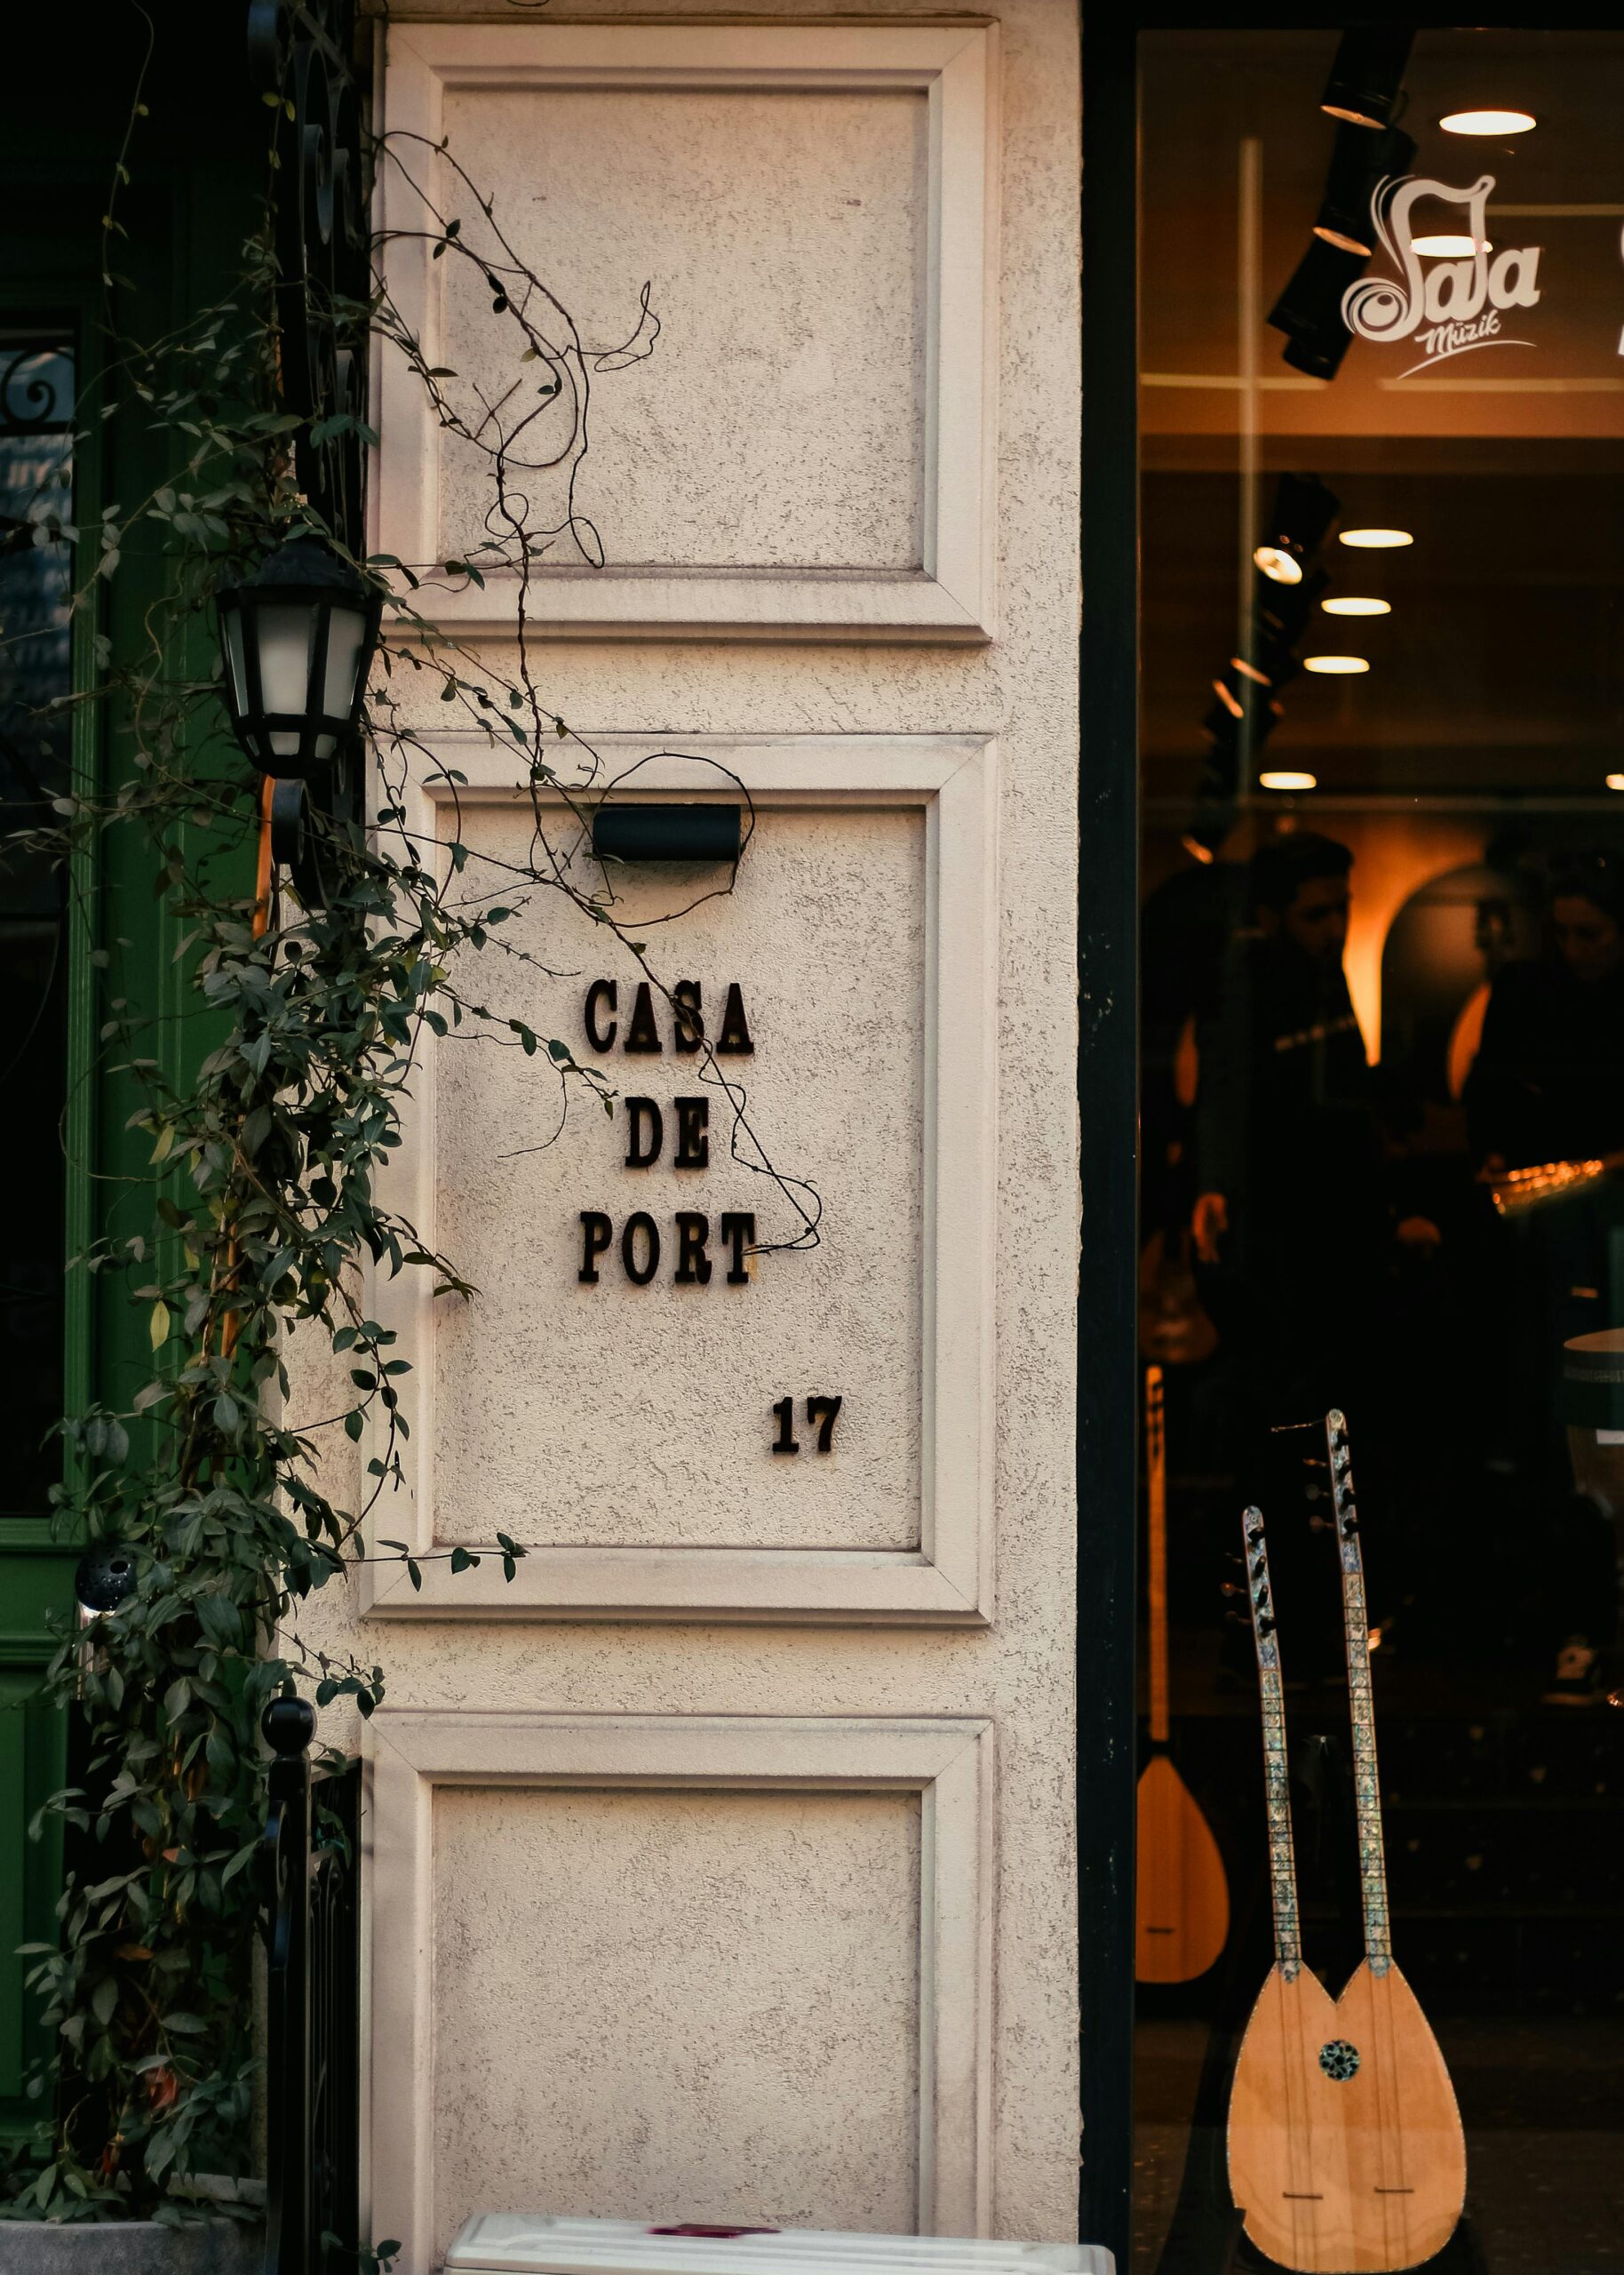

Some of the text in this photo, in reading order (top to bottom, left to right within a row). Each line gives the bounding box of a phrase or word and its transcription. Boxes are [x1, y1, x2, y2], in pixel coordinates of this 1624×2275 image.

[1414, 308, 1501, 355] Müzik
[585, 978, 754, 1054] CASA
[625, 1097, 710, 1169] DE
[578, 1211, 757, 1286] PORT
[772, 1395, 843, 1453] 17
